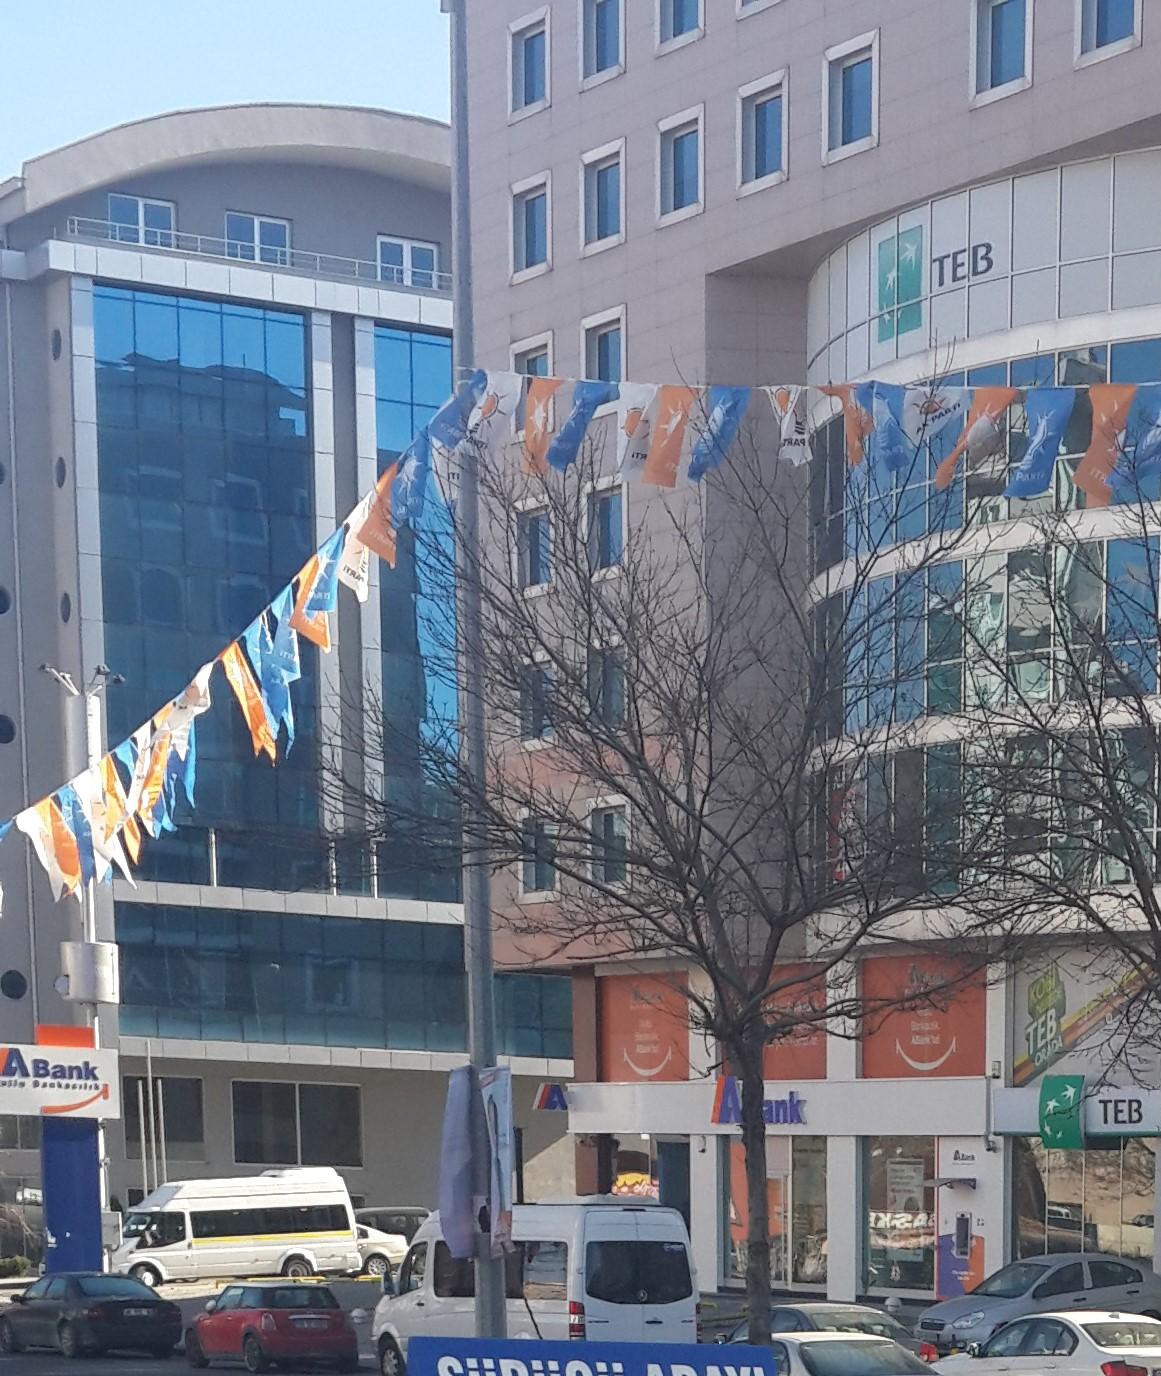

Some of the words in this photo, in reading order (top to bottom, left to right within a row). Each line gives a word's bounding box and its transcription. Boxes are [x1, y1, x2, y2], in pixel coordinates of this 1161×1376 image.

[932, 242, 994, 287] TEB
[1026, 1007, 1059, 1055] TEB
[711, 1073, 808, 1125] Aank
[1098, 1099, 1144, 1125] TEB
